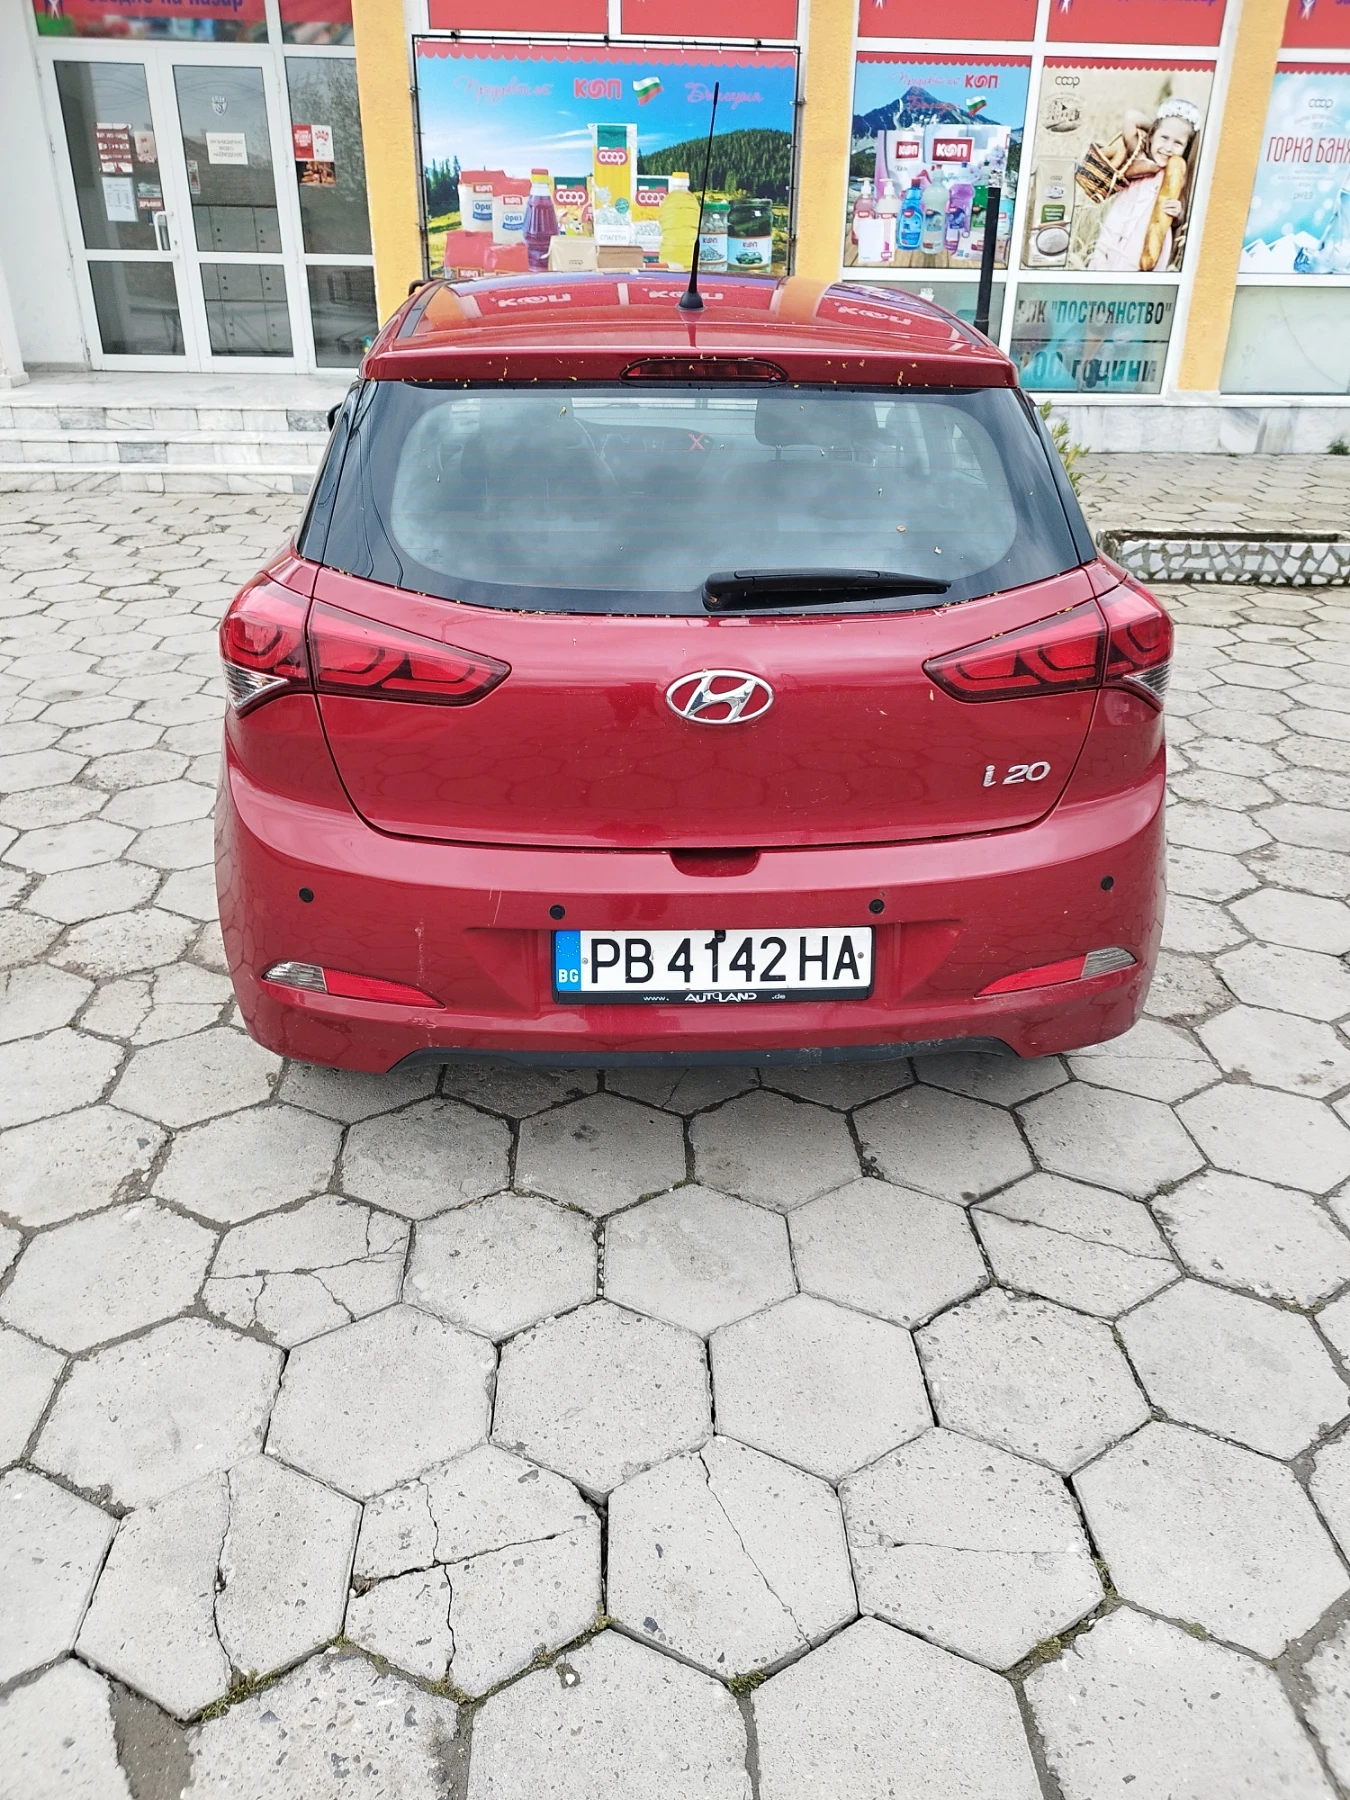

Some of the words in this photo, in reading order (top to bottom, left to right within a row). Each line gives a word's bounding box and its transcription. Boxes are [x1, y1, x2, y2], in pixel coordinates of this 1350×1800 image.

[573, 77, 623, 99] КОП
[964, 74, 999, 89] КОП
[936, 143, 968, 158] КОП
[556, 191, 586, 207] coop
[667, 936, 787, 983] 4142
[558, 969, 579, 983] BG
